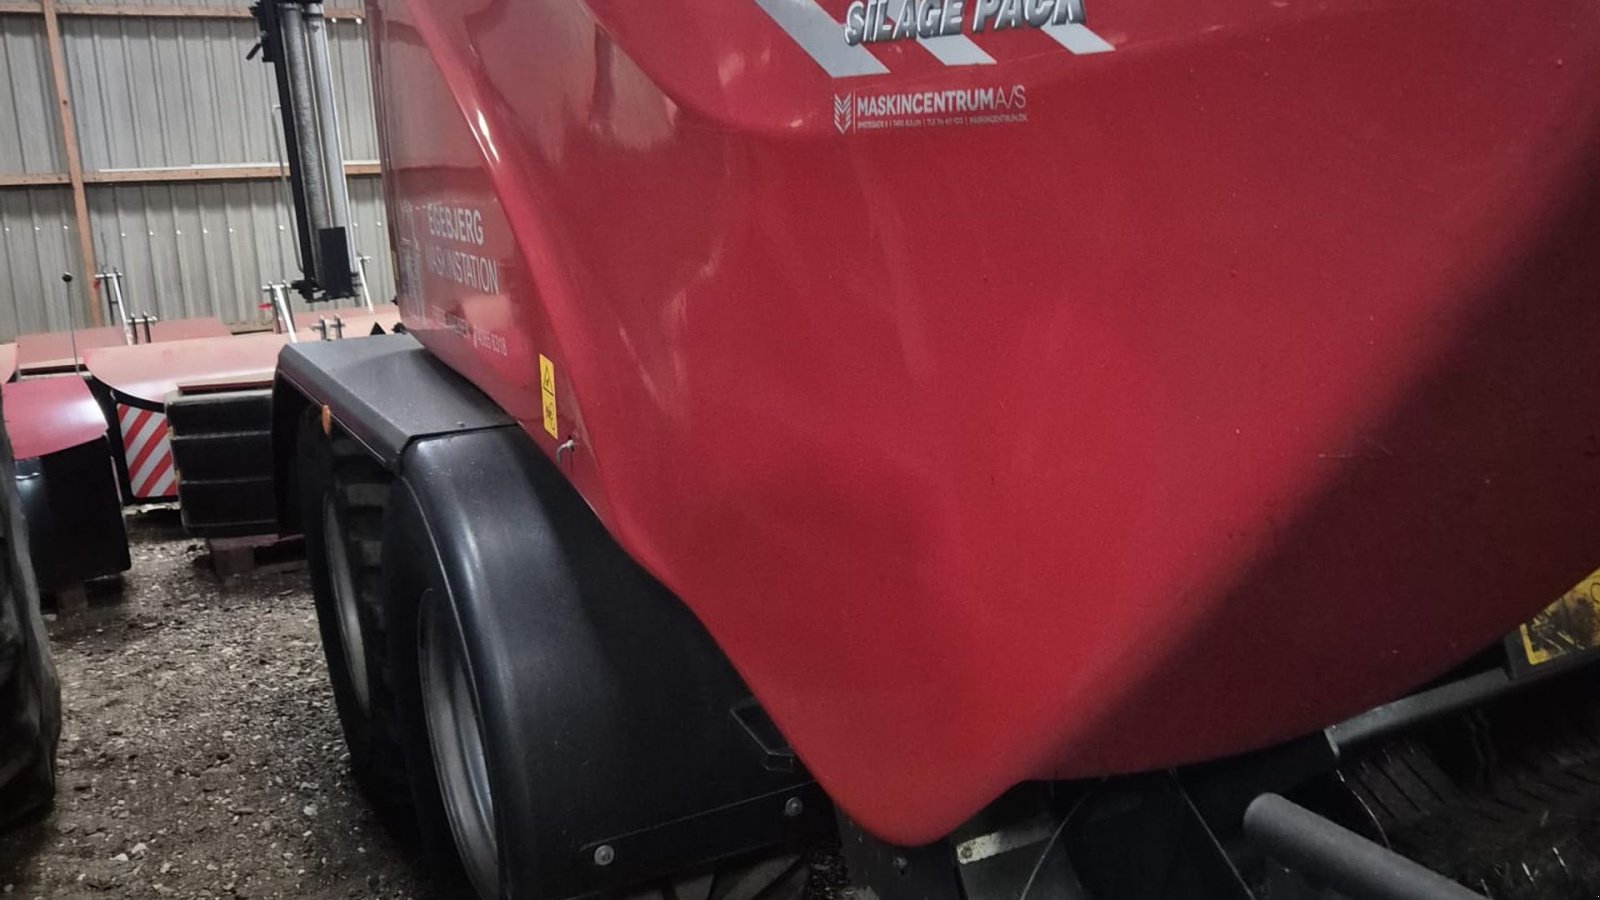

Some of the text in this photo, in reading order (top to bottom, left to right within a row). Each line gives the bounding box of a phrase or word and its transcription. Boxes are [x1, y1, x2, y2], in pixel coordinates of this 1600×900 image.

[844, 0, 1087, 46] SILAGE PACK
[428, 204, 483, 245] EGEBJERG
